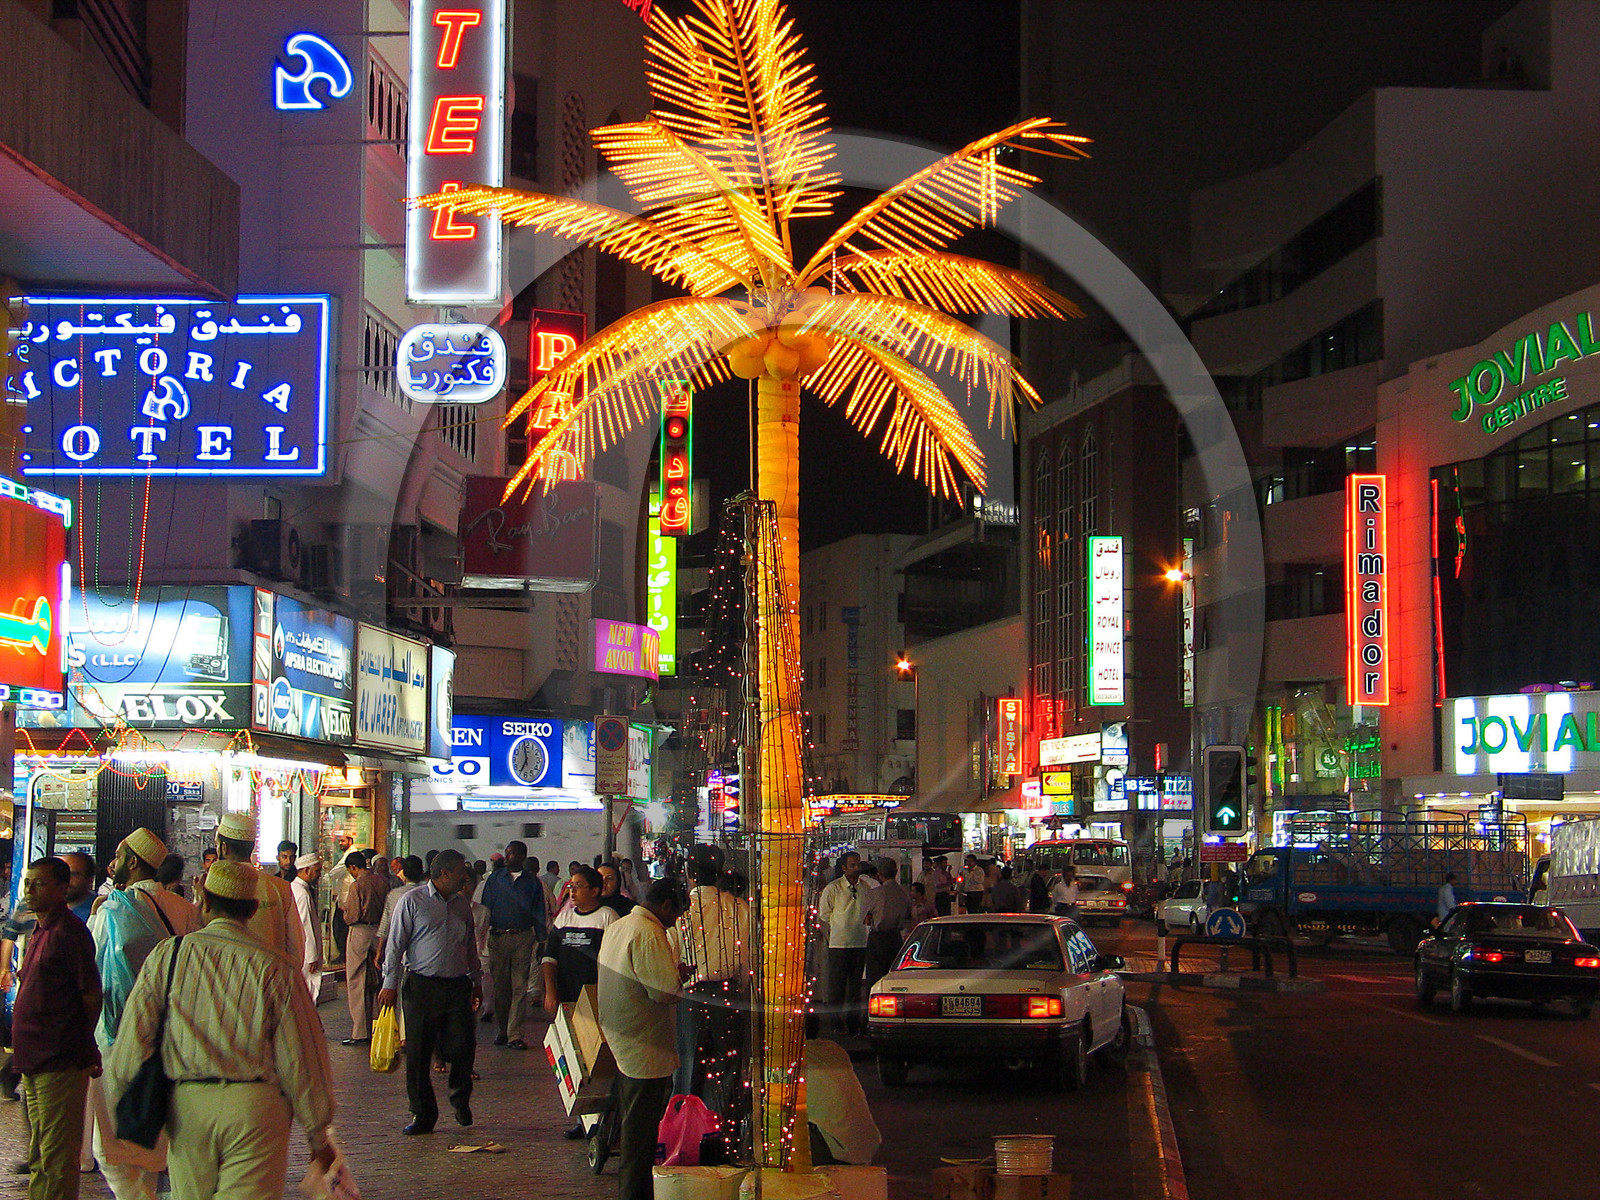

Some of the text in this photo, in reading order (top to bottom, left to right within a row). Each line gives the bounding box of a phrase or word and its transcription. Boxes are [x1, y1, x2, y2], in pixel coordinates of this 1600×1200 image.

[424, 9, 485, 240] TEL
[191, 305, 301, 341] فندق
[408, 332, 494, 362] فندق
[406, 358, 496, 395] فكتوريا
[1449, 312, 1600, 423] JOVIAL
[1481, 376, 1570, 435] CENTRE
[1357, 484, 1385, 695] Rimador
[607, 624, 635, 647] NEW
[1097, 616, 1119, 628] ROYAL
[604, 648, 635, 672] AVON
[1096, 642, 1121, 654] PRINCE
[1097, 669, 1119, 680] HOTEL
[320, 704, 352, 740] VELOX
[360, 688, 370, 732] AL
[370, 691, 398, 737] JABER
[502, 721, 553, 737] SEIKO
[1005, 702, 1016, 771] SWISTAR
[1461, 712, 1600, 755] JOVIAL
[1124, 779, 1138, 791] 18
[954, 996, 981, 1008] 84694
